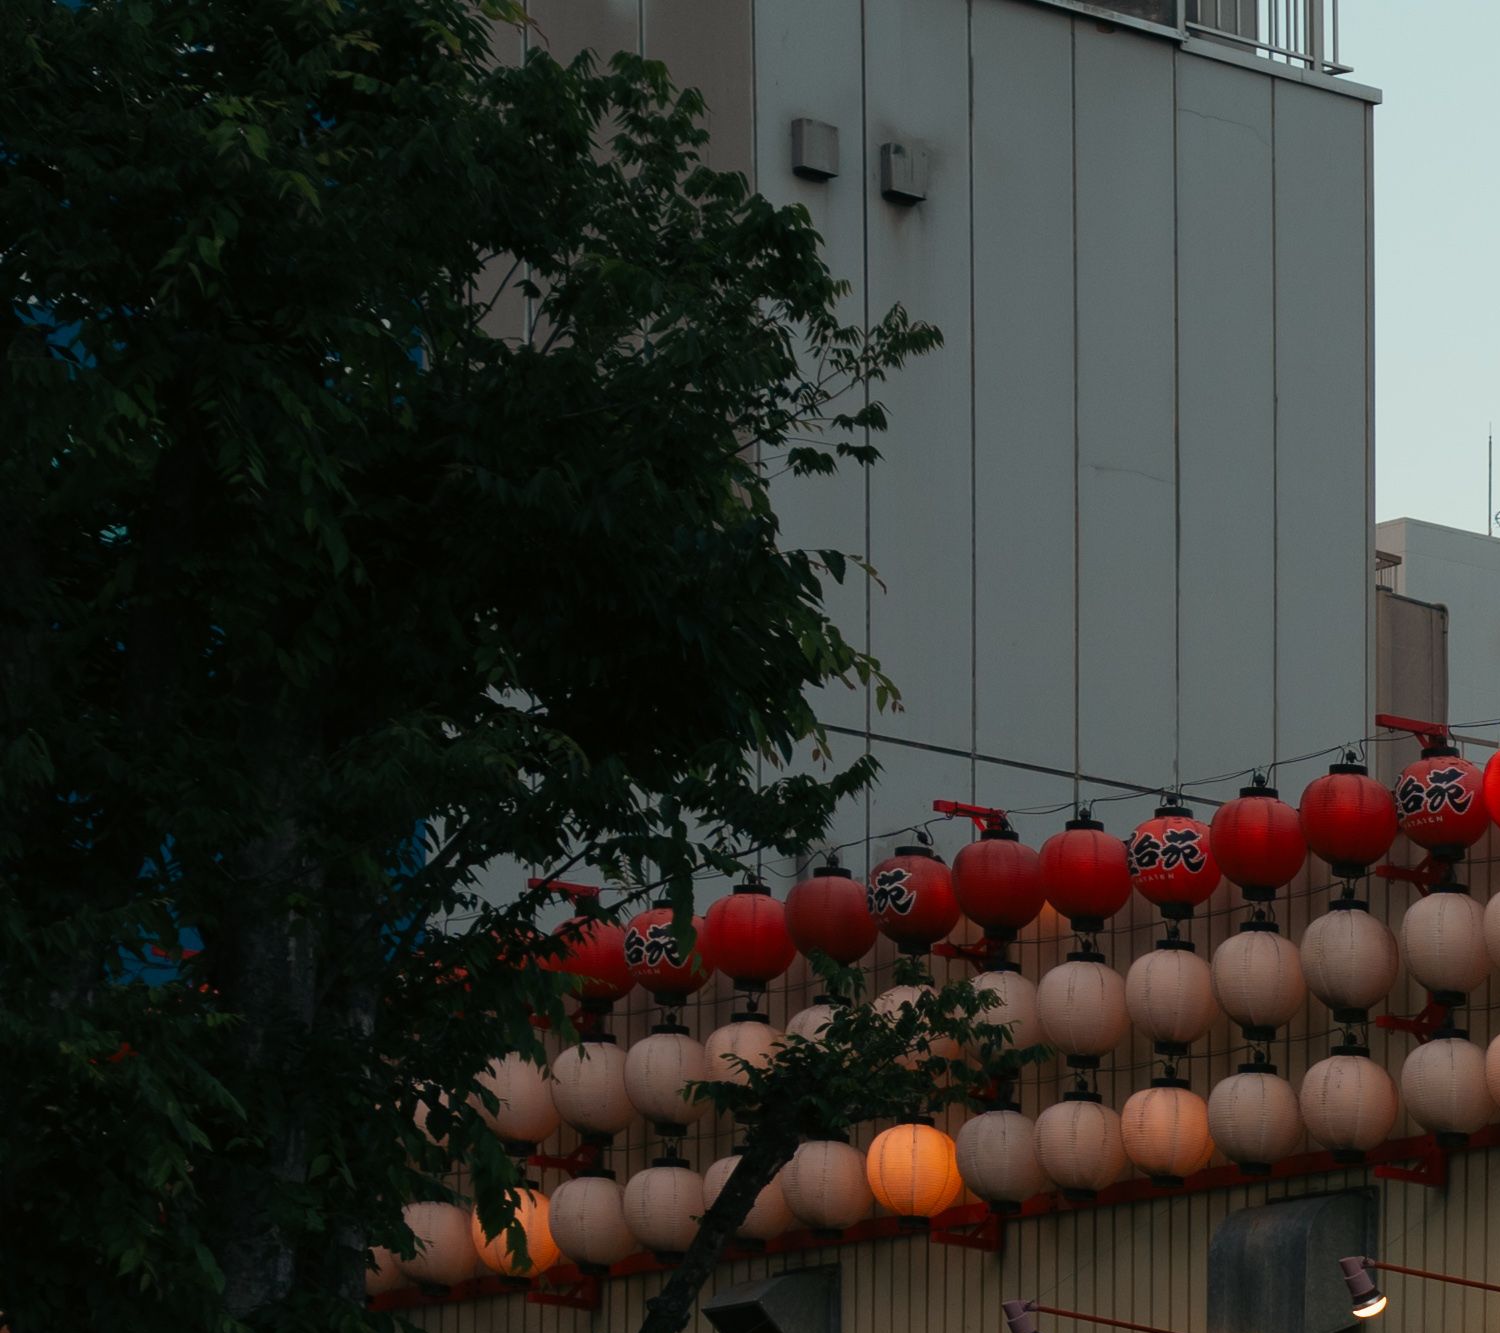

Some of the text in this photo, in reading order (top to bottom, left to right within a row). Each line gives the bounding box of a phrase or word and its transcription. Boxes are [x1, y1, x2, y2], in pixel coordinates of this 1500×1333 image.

[1396, 766, 1474, 818] 台苑
[1127, 827, 1207, 876] 台苑
[867, 866, 918, 917] 苑
